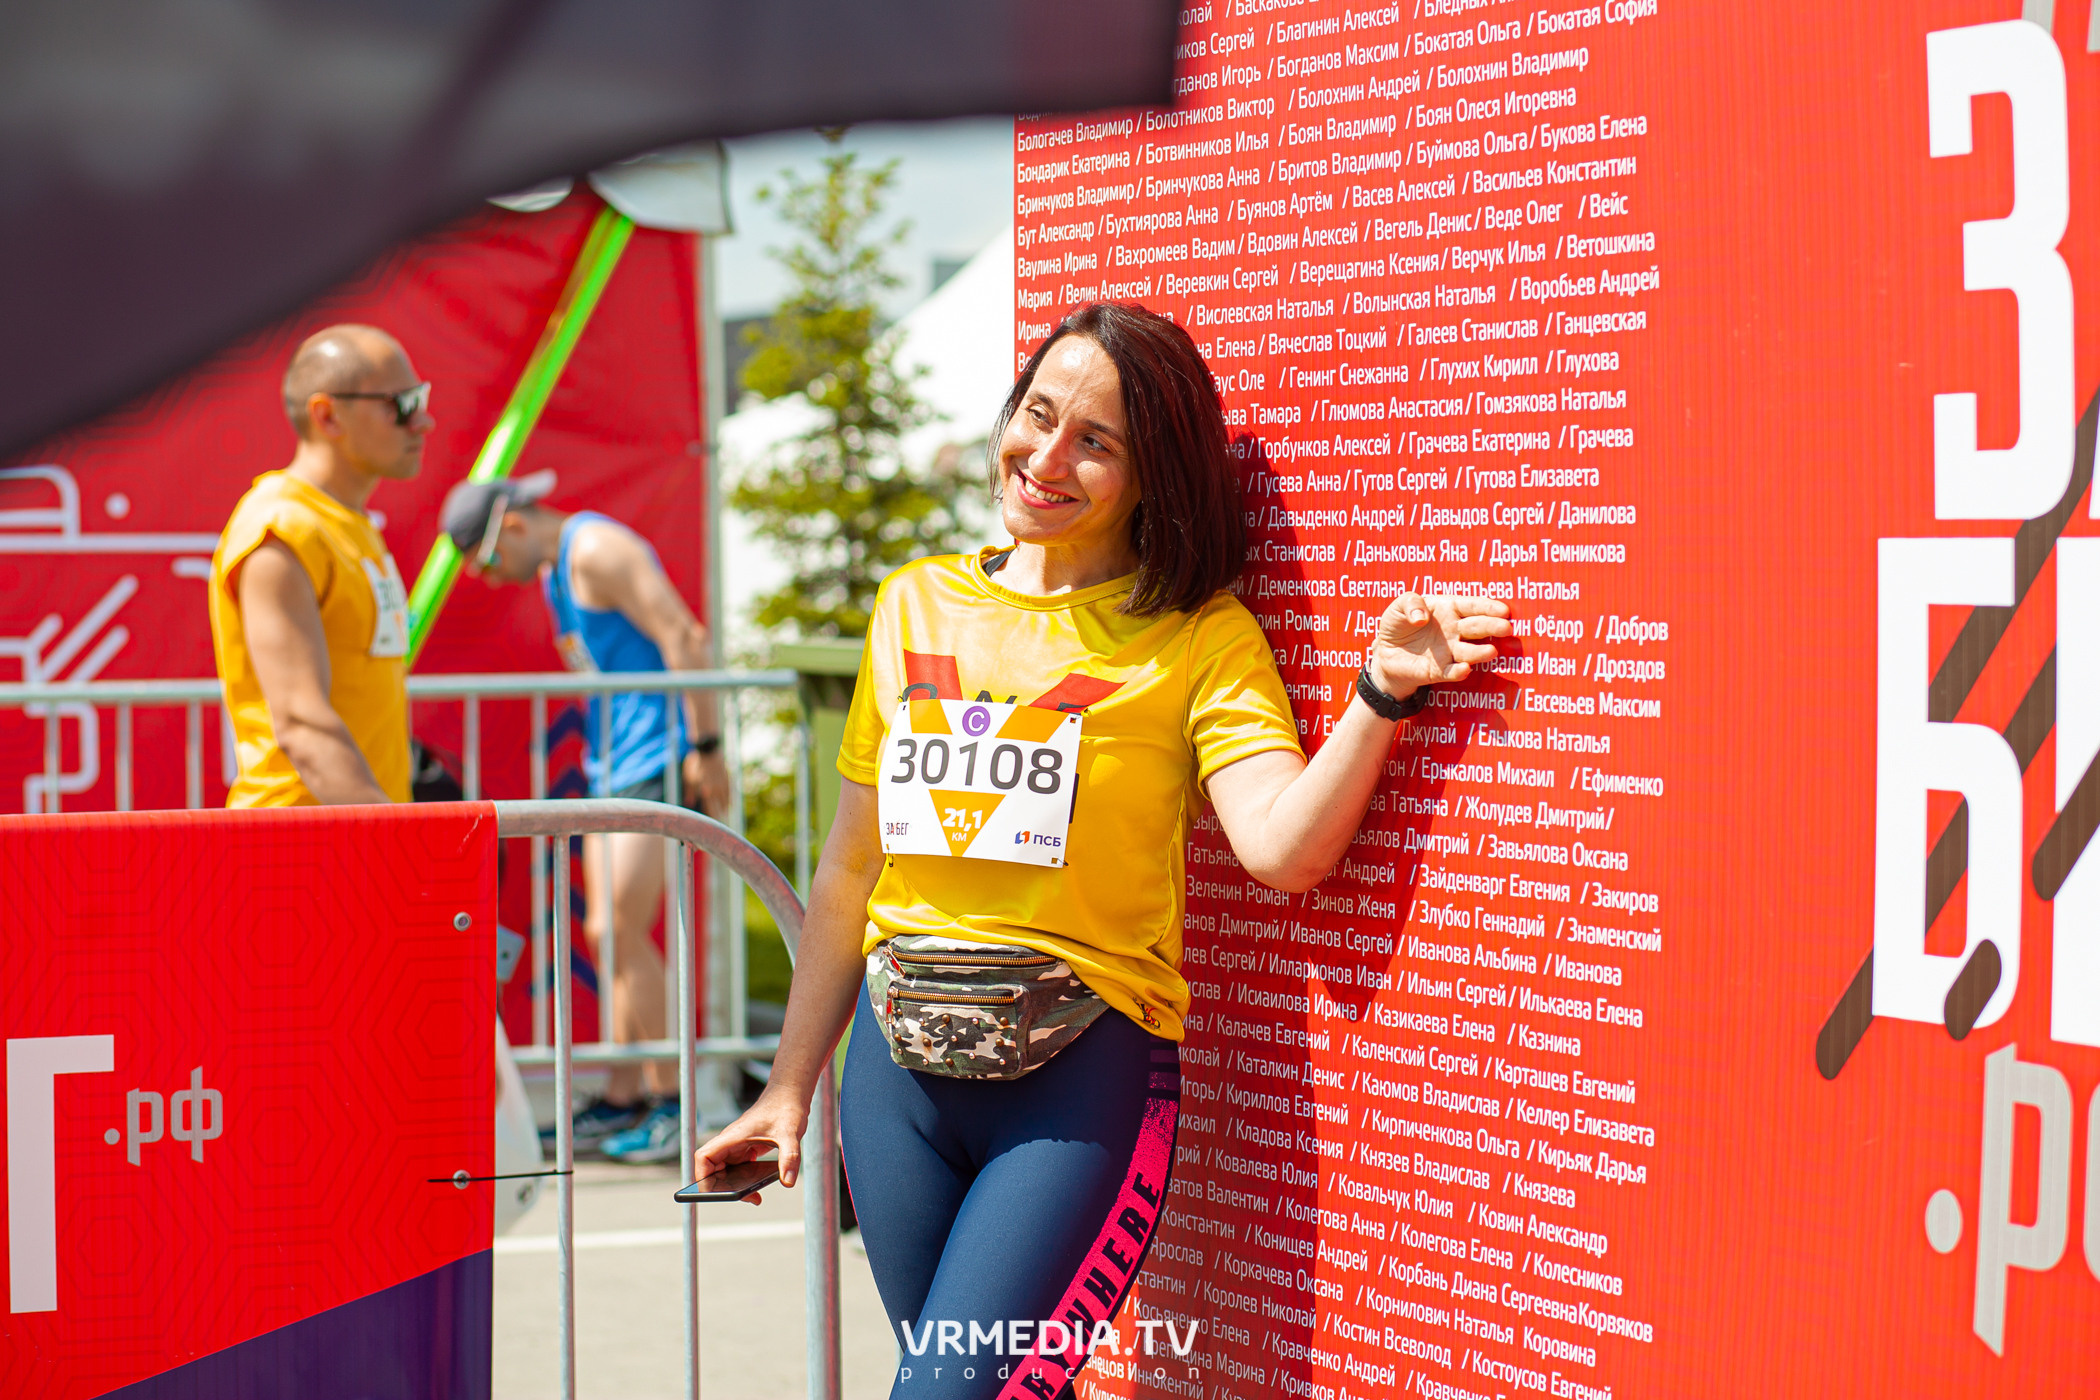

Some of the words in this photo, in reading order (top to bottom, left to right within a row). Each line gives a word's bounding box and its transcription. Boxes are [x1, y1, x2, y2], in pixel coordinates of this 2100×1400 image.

[890, 738, 1063, 795] 30108
[942, 807, 983, 832] 21,1
[1033, 834, 1062, 847] ПСБ
